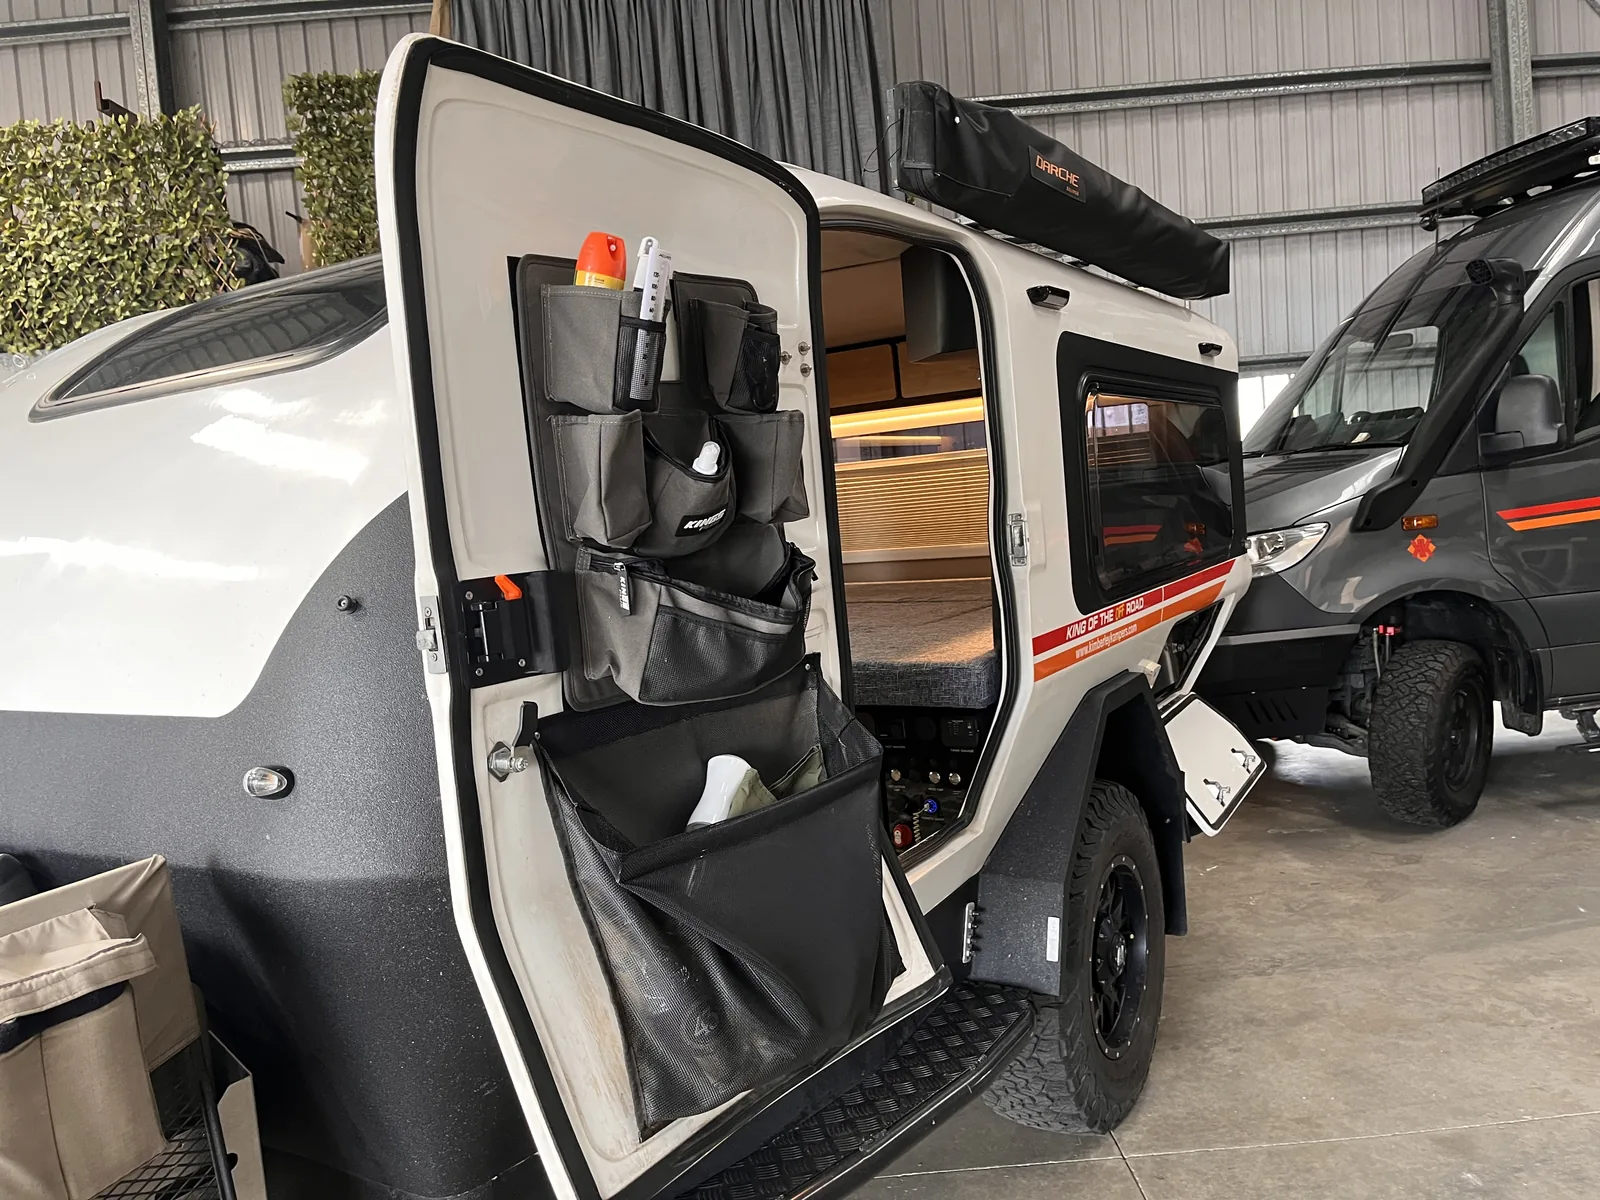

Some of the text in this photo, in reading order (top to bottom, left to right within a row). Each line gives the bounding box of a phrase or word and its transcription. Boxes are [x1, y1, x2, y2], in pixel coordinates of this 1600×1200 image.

[1036, 155, 1080, 187] DARCHE
[1066, 597, 1144, 640] KING OF THE OFF ROAD
[1075, 623, 1138, 659] www.kimberleykampers.com
